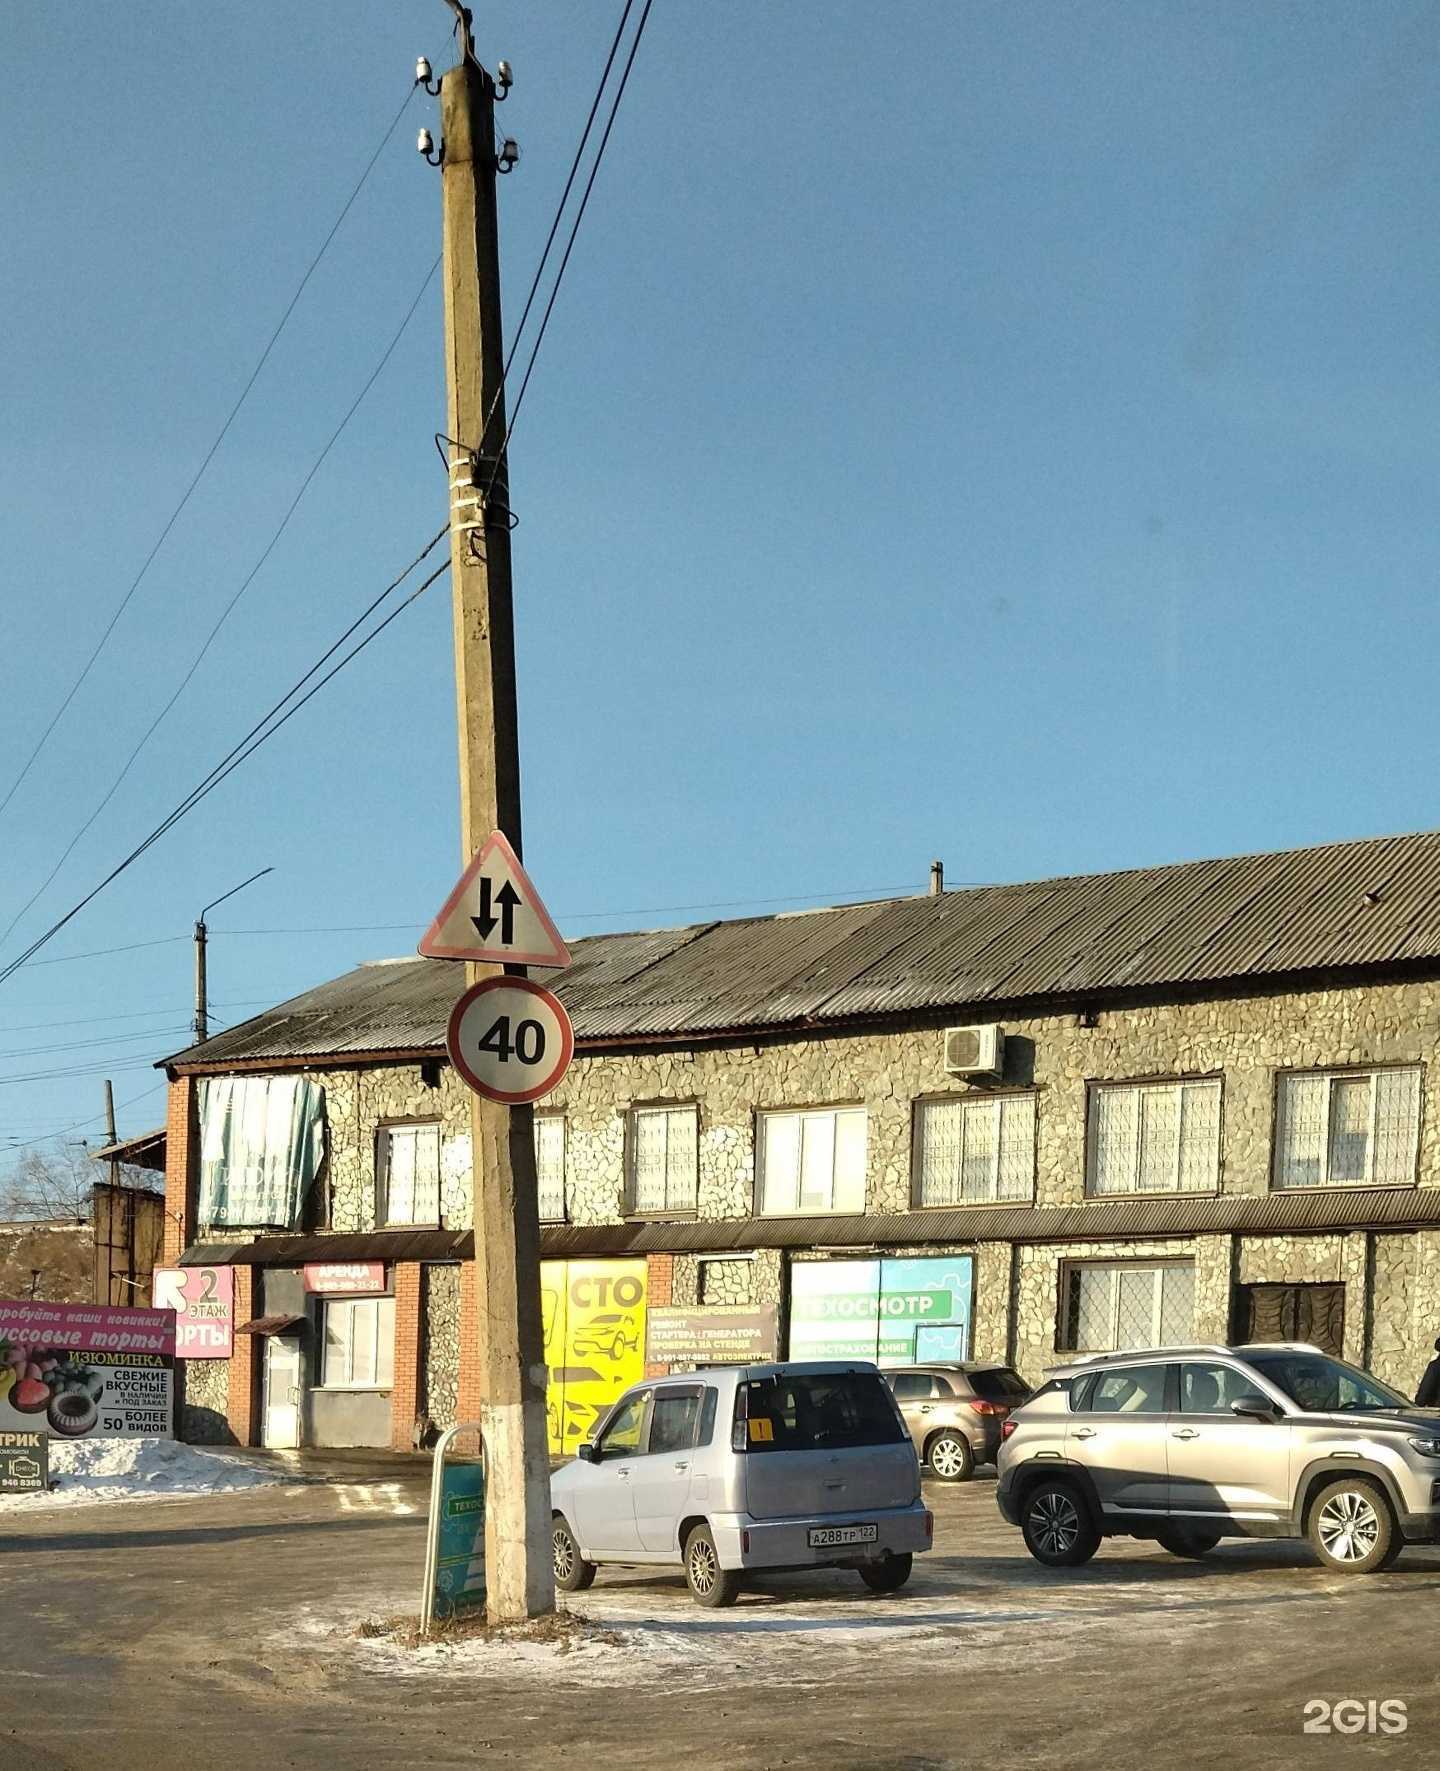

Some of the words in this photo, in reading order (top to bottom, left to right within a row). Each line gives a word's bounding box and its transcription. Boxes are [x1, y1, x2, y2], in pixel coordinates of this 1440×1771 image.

[478, 1015, 546, 1066] 40
[319, 1264, 369, 1279] АРЕНДА
[200, 1269, 218, 1303] 2
[571, 1276, 643, 1308] СТО
[0, 1306, 61, 1323] робуйте
[190, 1304, 227, 1318] ЭТАЖ
[90, 1332, 165, 1351] торты
[69, 1350, 164, 1367] ИЗЮМИНКА
[114, 1370, 168, 1382] СВЕЖИЕ
[106, 1381, 168, 1393] ВКУСНЫЕ
[104, 1417, 123, 1431] 50
[126, 1411, 168, 1423] БОЛЕЕ
[861, 1527, 874, 1537] 122
